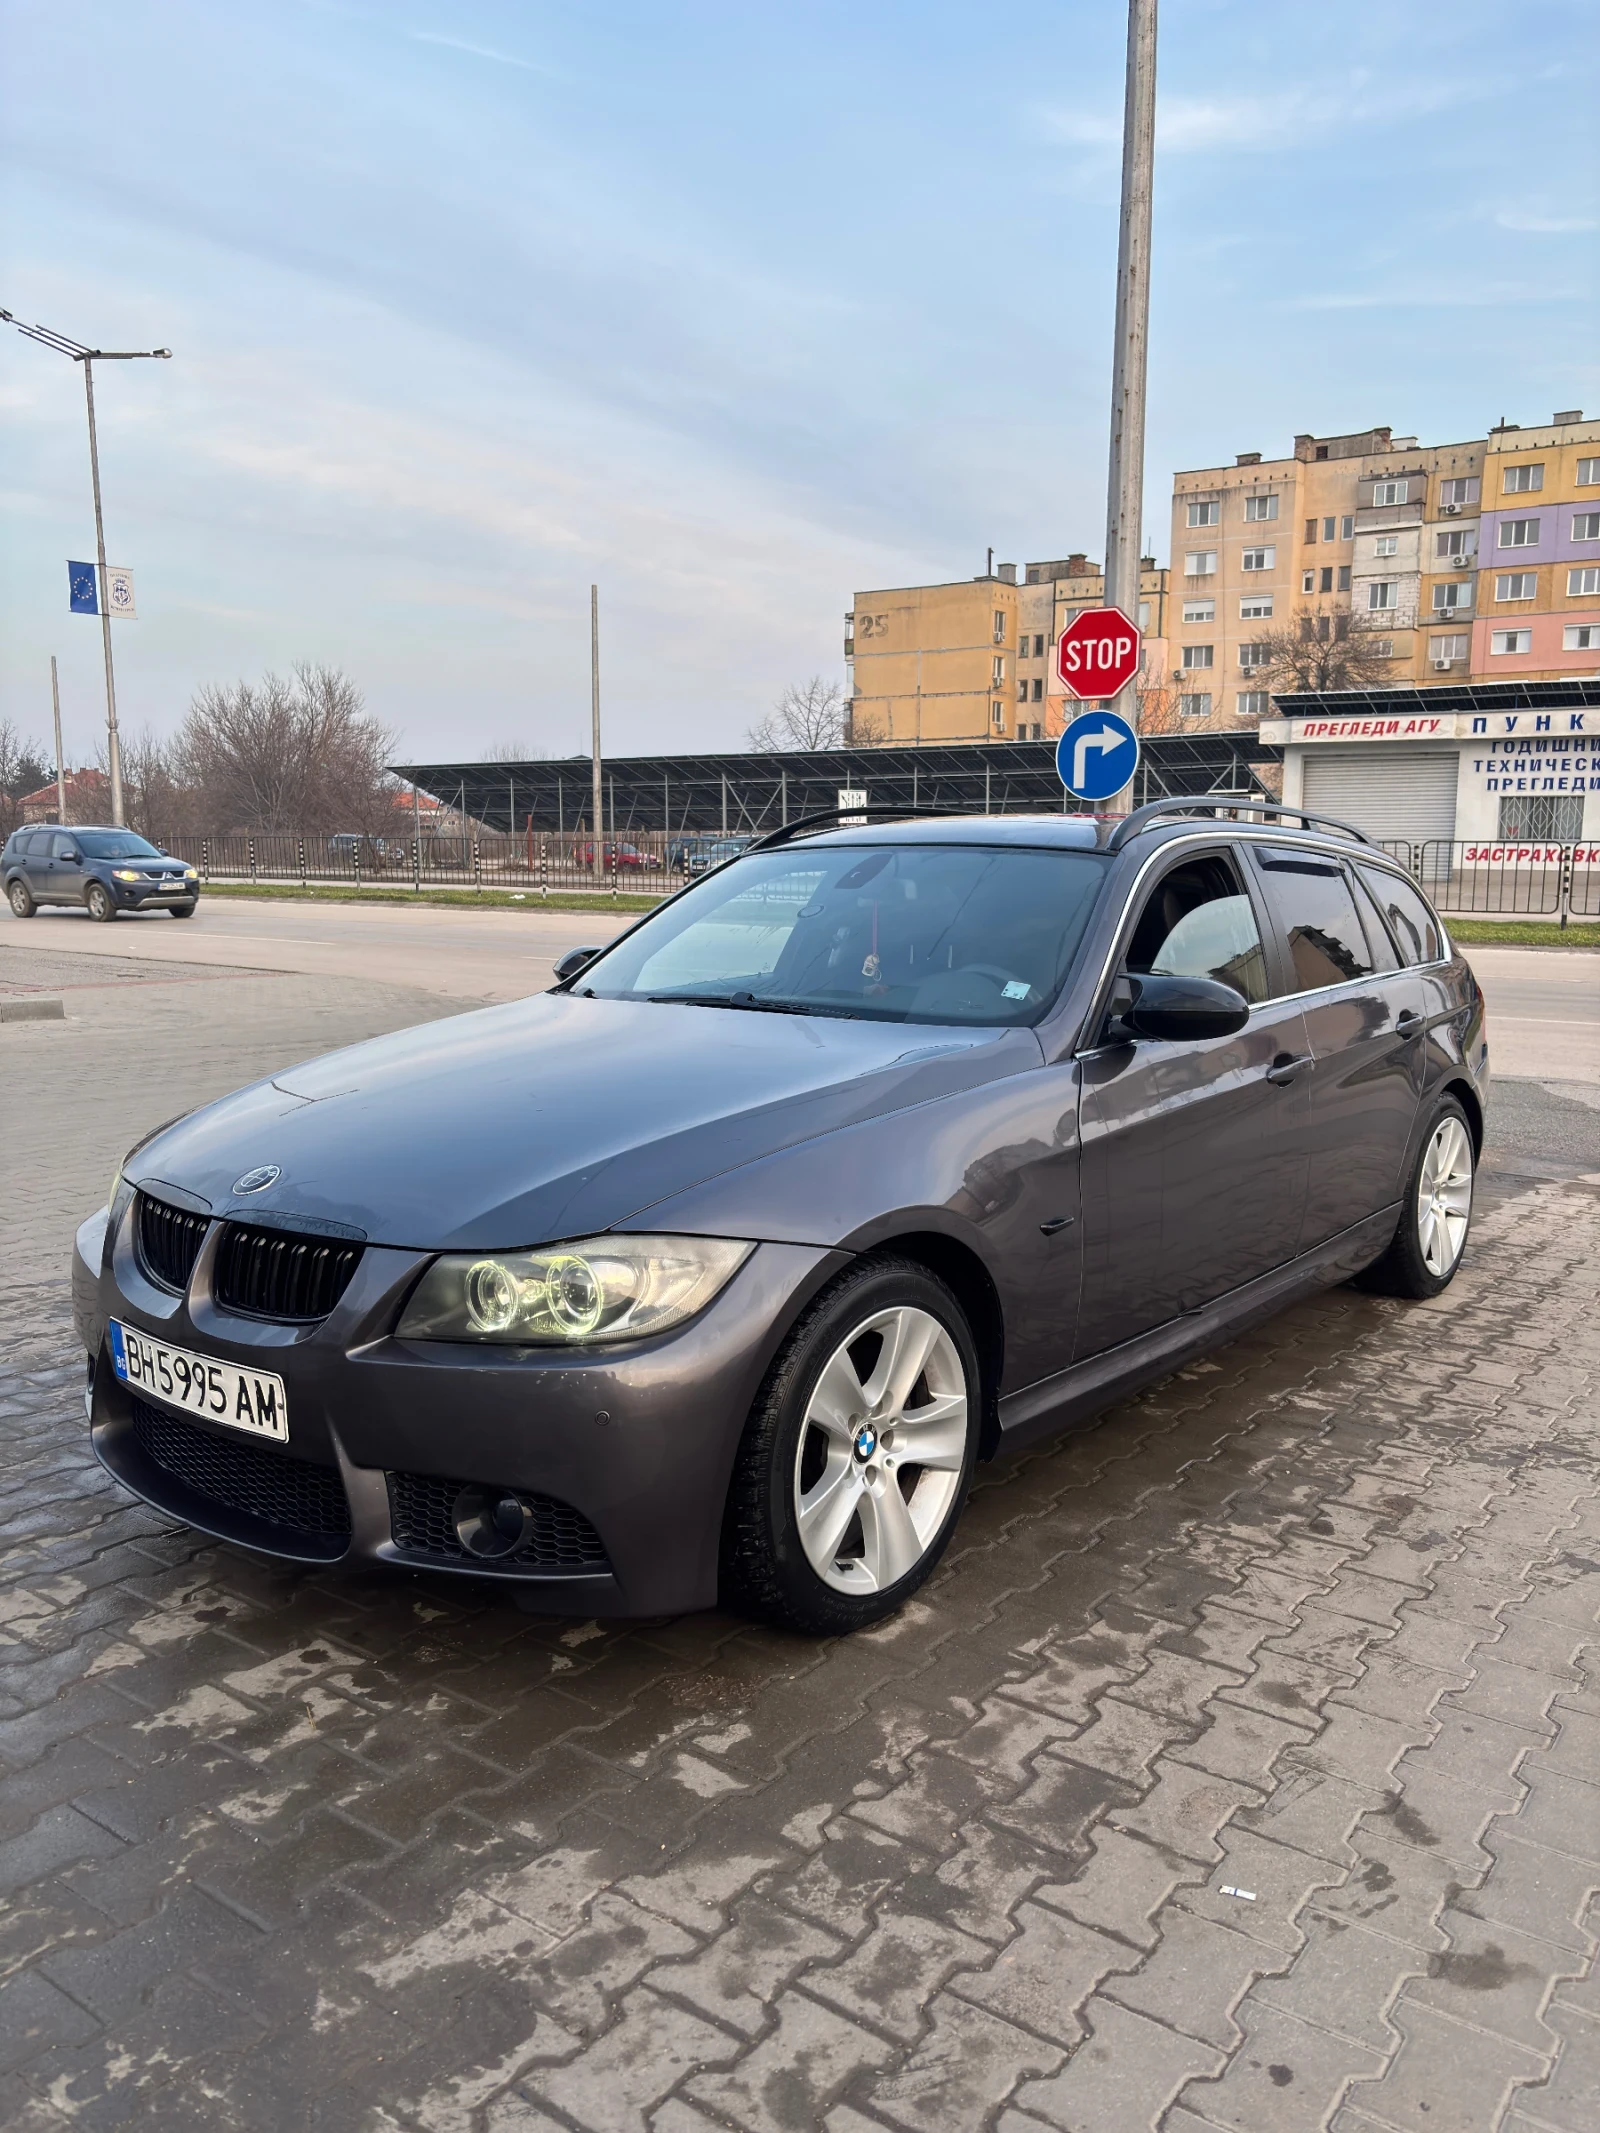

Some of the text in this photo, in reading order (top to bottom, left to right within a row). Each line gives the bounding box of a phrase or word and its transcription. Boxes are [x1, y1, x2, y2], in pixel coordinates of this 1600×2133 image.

[860, 614, 888, 639] 25
[1066, 637, 1131, 671] STOP
[1303, 719, 1440, 737] ПРЕГЛЕДИ АГУ
[1486, 776, 1600, 792] ПРЕГЛЕДИ
[116, 1355, 126, 1370] BG
[236, 1375, 278, 1430] AM
